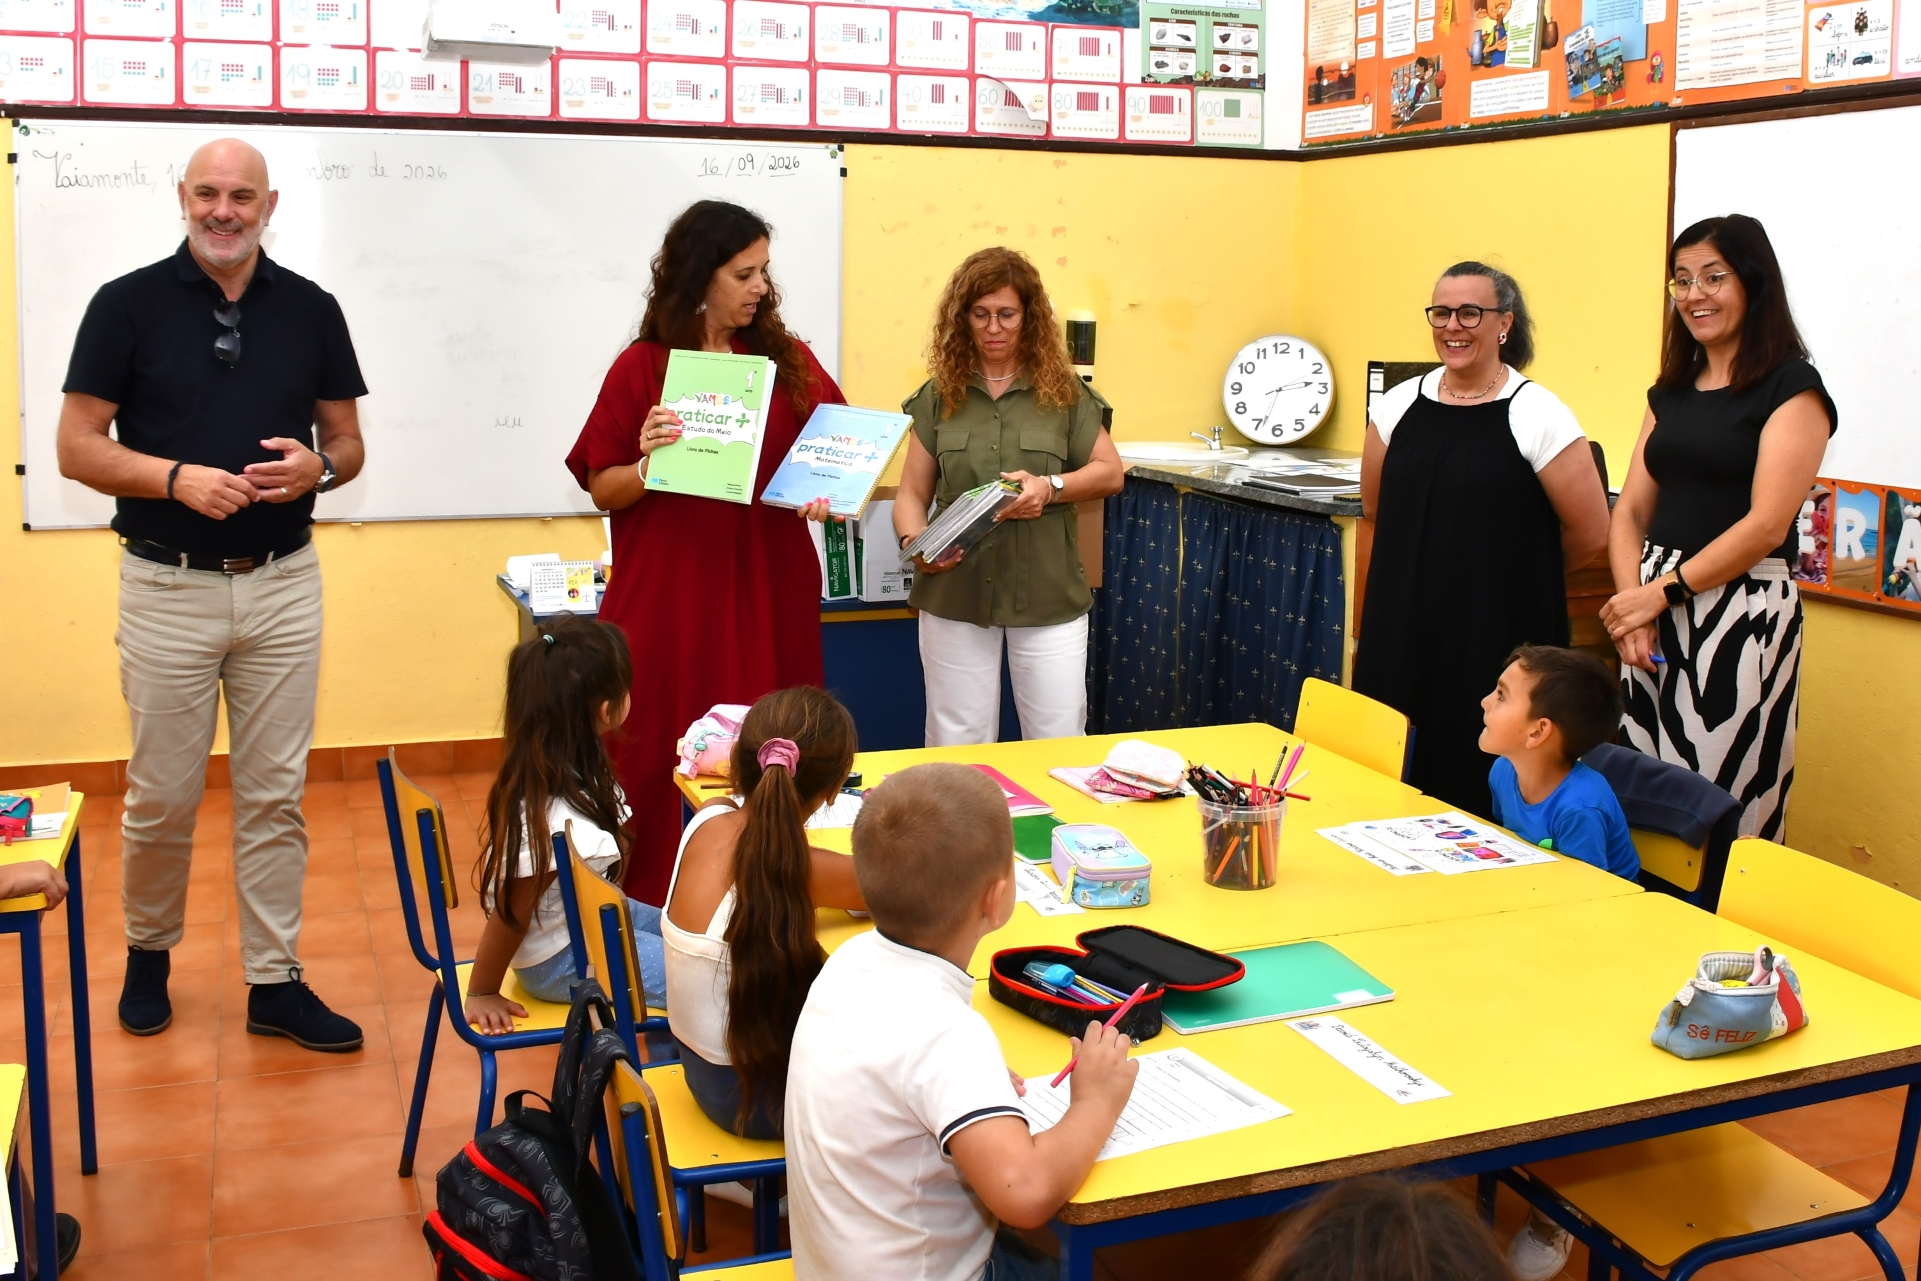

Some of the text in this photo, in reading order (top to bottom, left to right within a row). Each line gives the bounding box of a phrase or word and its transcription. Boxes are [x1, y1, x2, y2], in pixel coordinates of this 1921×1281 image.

[564, 11, 587, 29] 22
[651, 14, 672, 32] 24
[1211, 10, 1221, 18] das
[1222, 11, 1240, 19] rochas
[737, 18, 758, 37] 26
[819, 24, 840, 42] 28
[901, 21, 922, 39] 30
[978, 33, 998, 50] 50
[1056, 38, 1074, 56] 70
[0, 52, 12, 75] 3
[91, 57, 115, 79] 15
[190, 58, 213, 81] 17
[286, 63, 311, 86] 19
[380, 70, 404, 90] 20
[473, 73, 493, 92] 21
[563, 78, 587, 97] 23
[651, 80, 673, 99] 25
[737, 85, 757, 102] 27
[820, 87, 841, 105] 29
[902, 85, 922, 103] 40
[978, 88, 999, 106] 60
[1054, 92, 1073, 110] 80
[1127, 97, 1146, 114] 90
[1199, 101, 1222, 118] 100
[368, 151, 389, 178] de
[402, 164, 448, 180] 2026
[1256, 347, 1267, 360] 11
[1272, 342, 1290, 354] 12
[1298, 347, 1304, 360] 1
[1238, 361, 1256, 375] 10
[1311, 362, 1323, 375] 2
[1230, 381, 1243, 395] 9
[1317, 382, 1329, 395] 3
[694, 393, 731, 406] VAMOS
[1234, 401, 1248, 415] 8
[675, 409, 732, 426] raticar
[1308, 403, 1321, 416] 4
[681, 424, 732, 436] Estudo do Meio
[1251, 418, 1263, 431] 7
[1271, 424, 1284, 437] 6
[1293, 418, 1305, 432] 5
[796, 443, 862, 460] praticar
[838, 542, 846, 551] 80
[832, 557, 840, 592] NAVIGATOR
[882, 585, 891, 594] 80
[1687, 1023, 1757, 1043] Sê FELIZ
